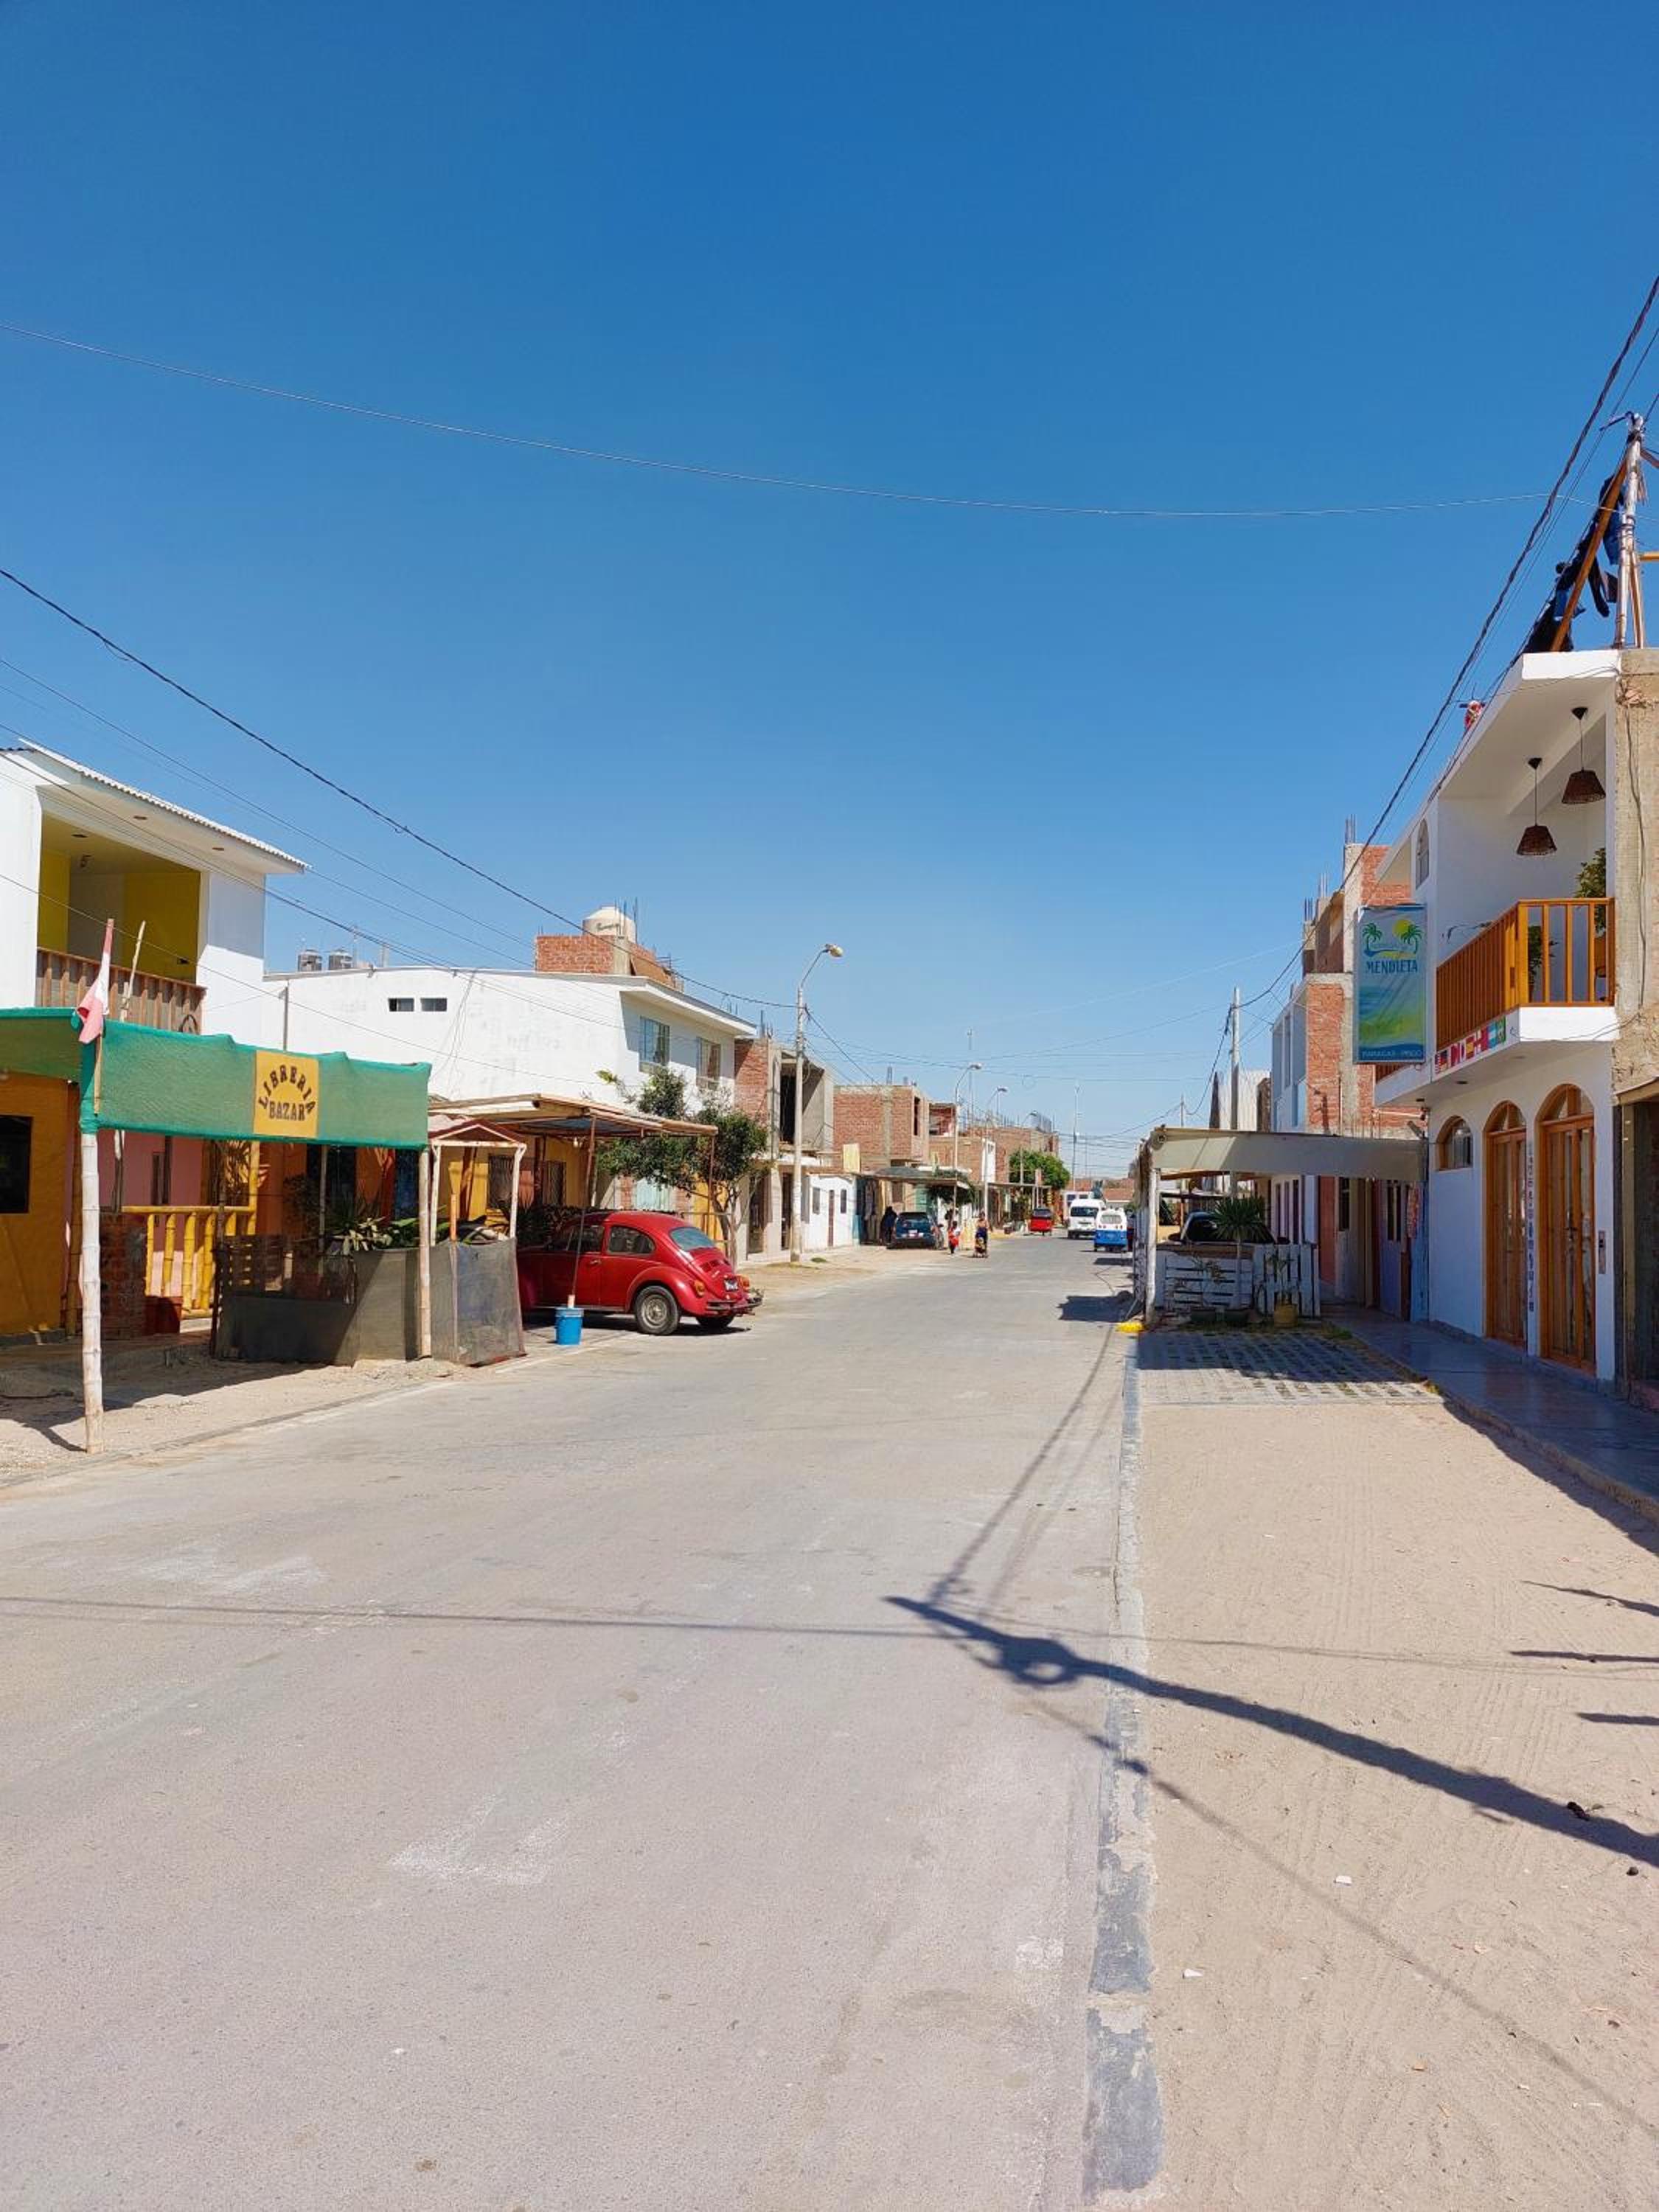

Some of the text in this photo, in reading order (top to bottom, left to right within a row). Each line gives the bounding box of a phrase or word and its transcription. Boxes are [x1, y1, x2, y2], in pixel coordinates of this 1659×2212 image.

[1366, 959, 1418, 973] MENDIETA
[258, 1064, 316, 1114] LIBRERIA
[268, 1101, 305, 1121] BAZAR
